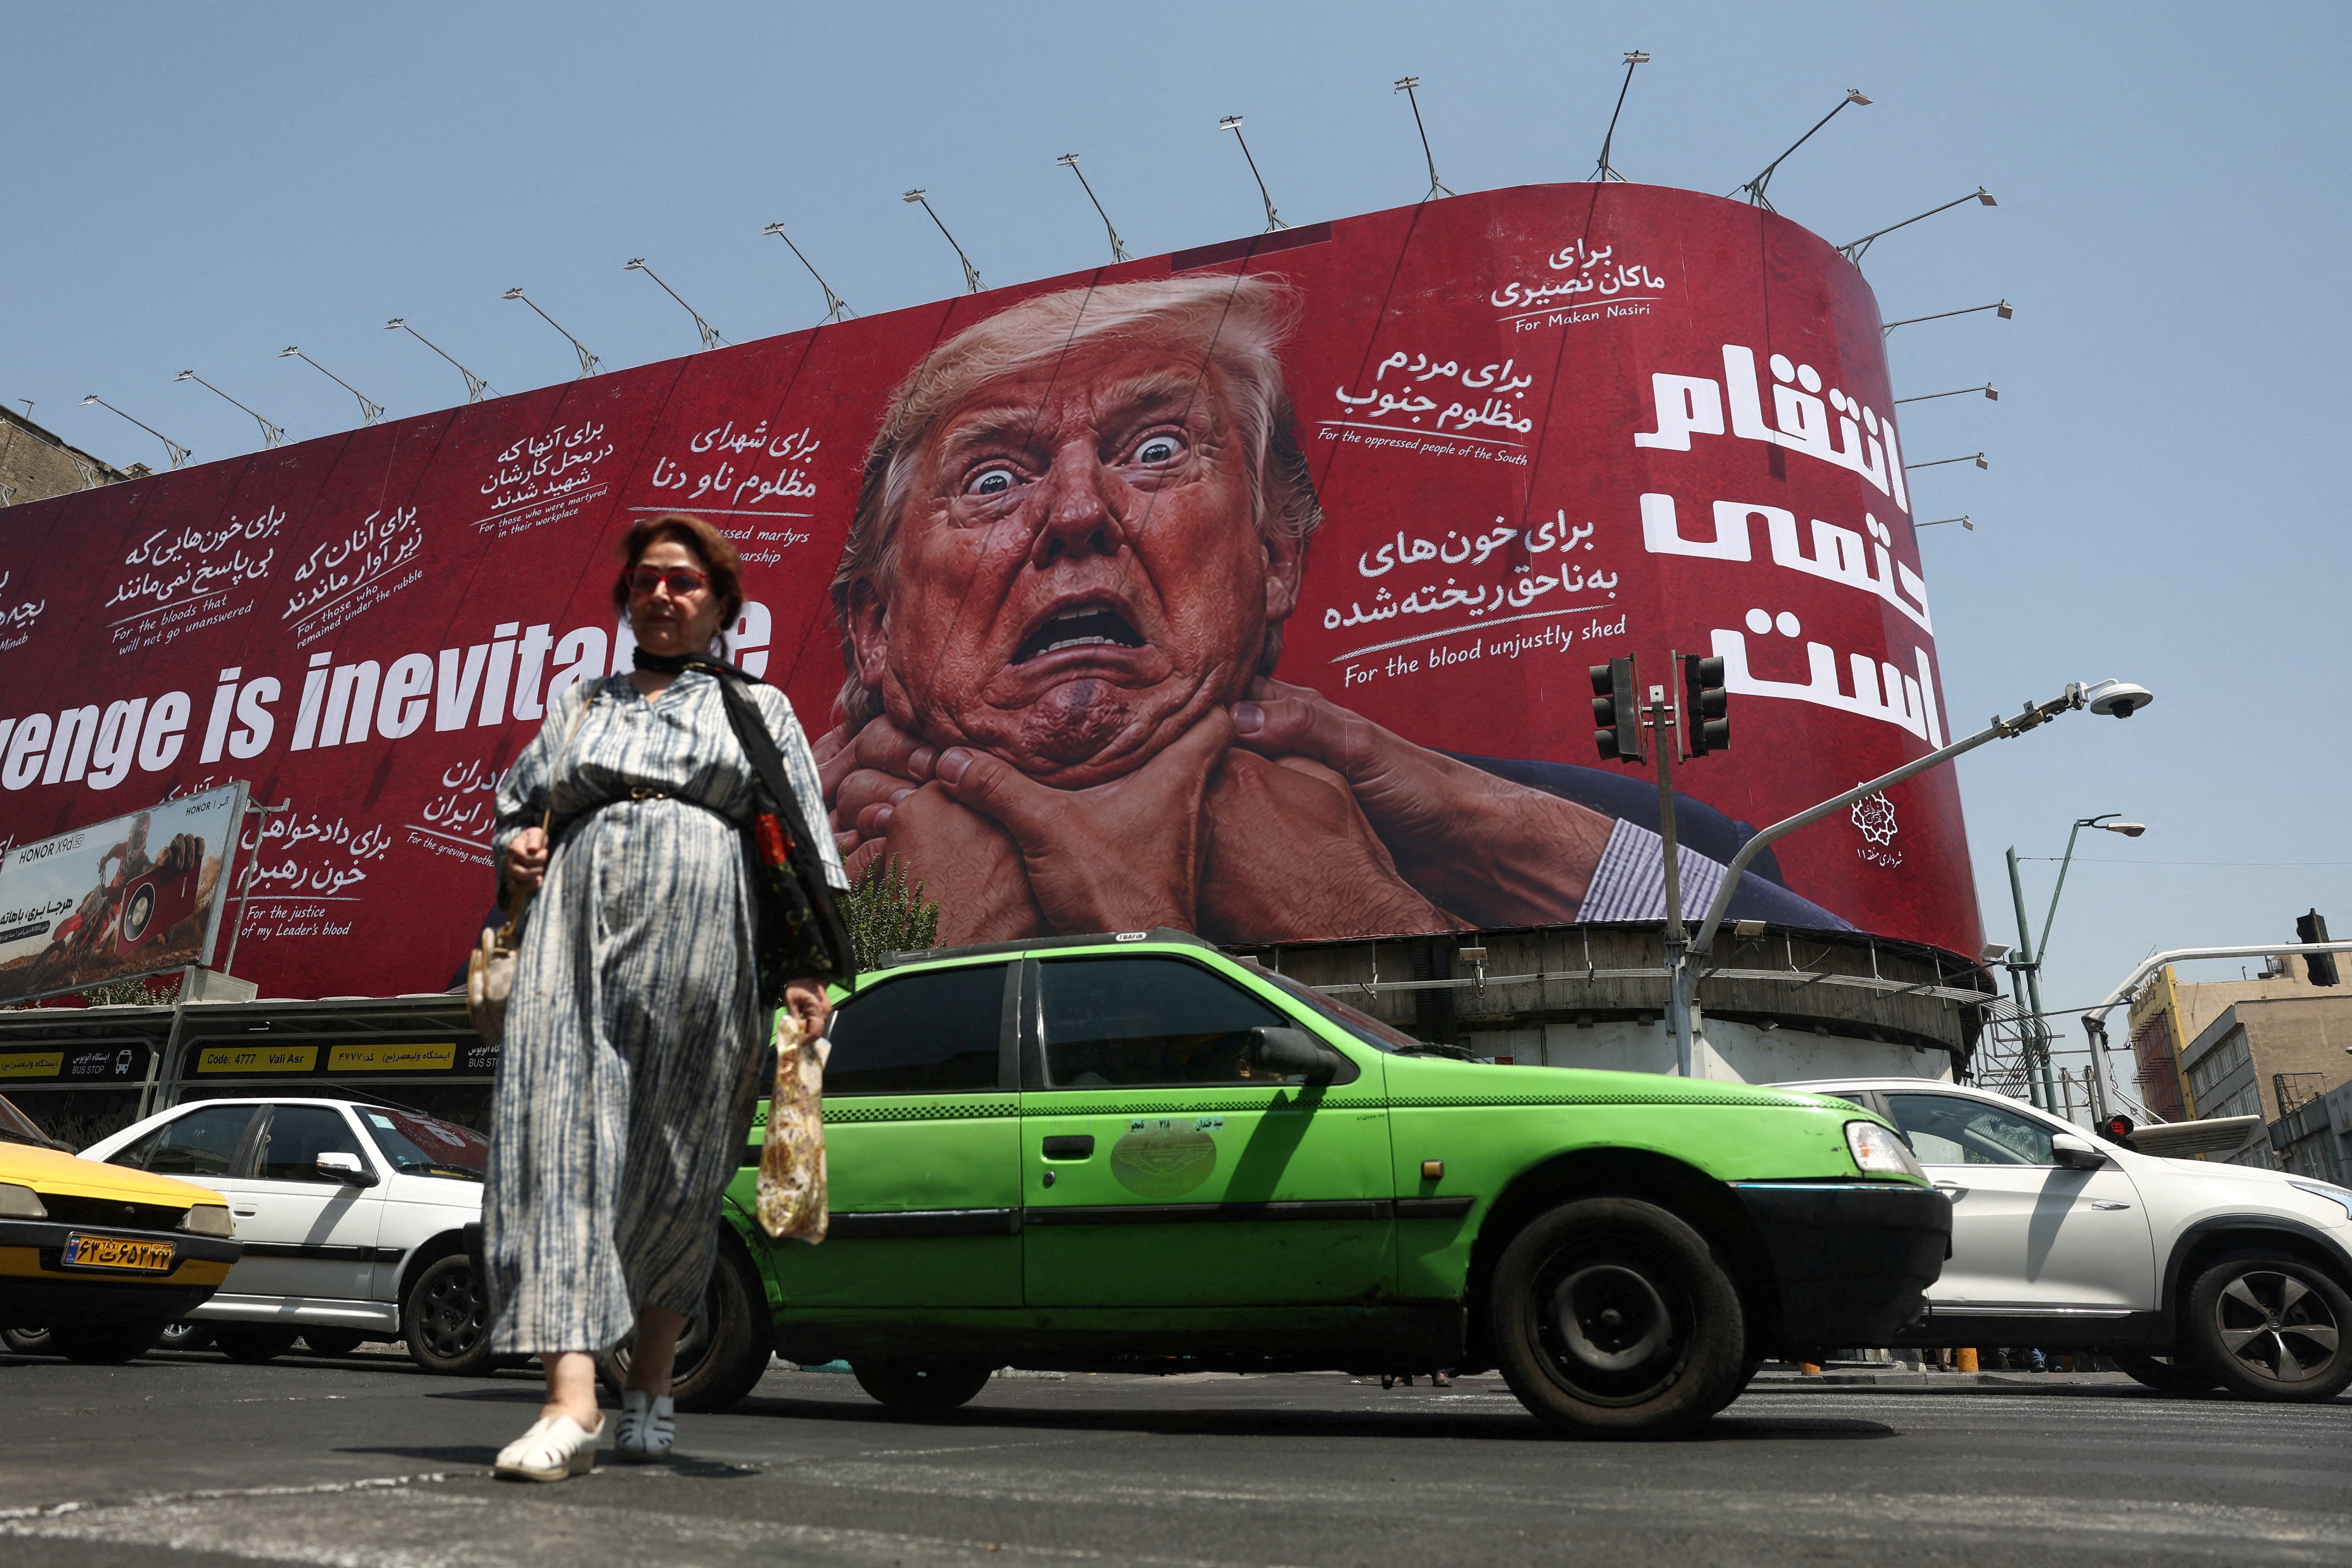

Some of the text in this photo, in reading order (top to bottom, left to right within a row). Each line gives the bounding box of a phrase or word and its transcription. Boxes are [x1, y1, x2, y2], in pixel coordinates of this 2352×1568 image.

[1549, 238, 1612, 270] برای
[1491, 265, 1665, 307] ماکان نصیری
[1516, 304, 1649, 332] For Makan Nasiri
[1377, 352, 1532, 399] برای مردم
[1336, 385, 1532, 432] مظلوم جنوب
[498, 421, 604, 462] برای آنها که
[691, 421, 820, 463] برای شهدای
[1318, 428, 1527, 466] For the oppressed people of the South
[1634, 344, 1908, 514] انتقام
[491, 468, 590, 509] شهید شدند
[653, 457, 816, 505] مظلوم ناو دنا
[245, 505, 285, 539] برای
[479, 486, 607, 533] For those who were martyred
[511, 521, 532, 534] their
[536, 508, 578, 526] workplace
[126, 529, 167, 564] که
[295, 507, 416, 581] برای آنان که
[717, 525, 810, 547] essed martyrs
[1525, 509, 1594, 551] برای
[282, 528, 422, 619] زیر آوار ماندند
[1640, 493, 1934, 637] حتمی
[113, 595, 227, 643] For the bloods that
[120, 599, 253, 655] will not go unanswered
[298, 570, 422, 649] remained under the rubble
[298, 586, 379, 637] For those who
[0, 632, 28, 650] Minab
[1345, 614, 1626, 688] For the blood unjustly shed
[0, 601, 772, 790] enge is inevitae
[1711, 608, 1942, 749] است
[442, 759, 508, 795] ادران
[186, 802, 211, 816] HONOR
[423, 795, 481, 831] ایران
[19, 842, 54, 864] HONOR
[56, 837, 74, 854] X9d
[75, 837, 82, 846] 5G
[237, 813, 391, 860] برای دادخواهی
[407, 832, 421, 844] For
[423, 838, 436, 849] the
[436, 845, 468, 862] grieving
[1858, 847, 1902, 868] شهرداری منطقه ۱۱
[236, 858, 366, 899] خون رهبرم
[240, 922, 352, 940] of my Leader's blood
[244, 905, 325, 922] For the justice
[35, 1059, 58, 1068] ایستگاه
[73, 1052, 110, 1064] ایستگاه اتوبوس
[207, 1054, 304, 1064] Code: 4777 Vali Asr
[423, 1050, 450, 1061] ایستگاه
[468, 1045, 490, 1056] اتوبوس
[468, 1058, 499, 1067] BUS ST
[72, 1065, 105, 1074] BUS STOP
[77, 1240, 100, 1262] ۶۳
[99, 1251, 116, 1262] ت
[117, 1243, 149, 1265] ۶۵۳
[102, 1242, 119, 1251] TAXI
